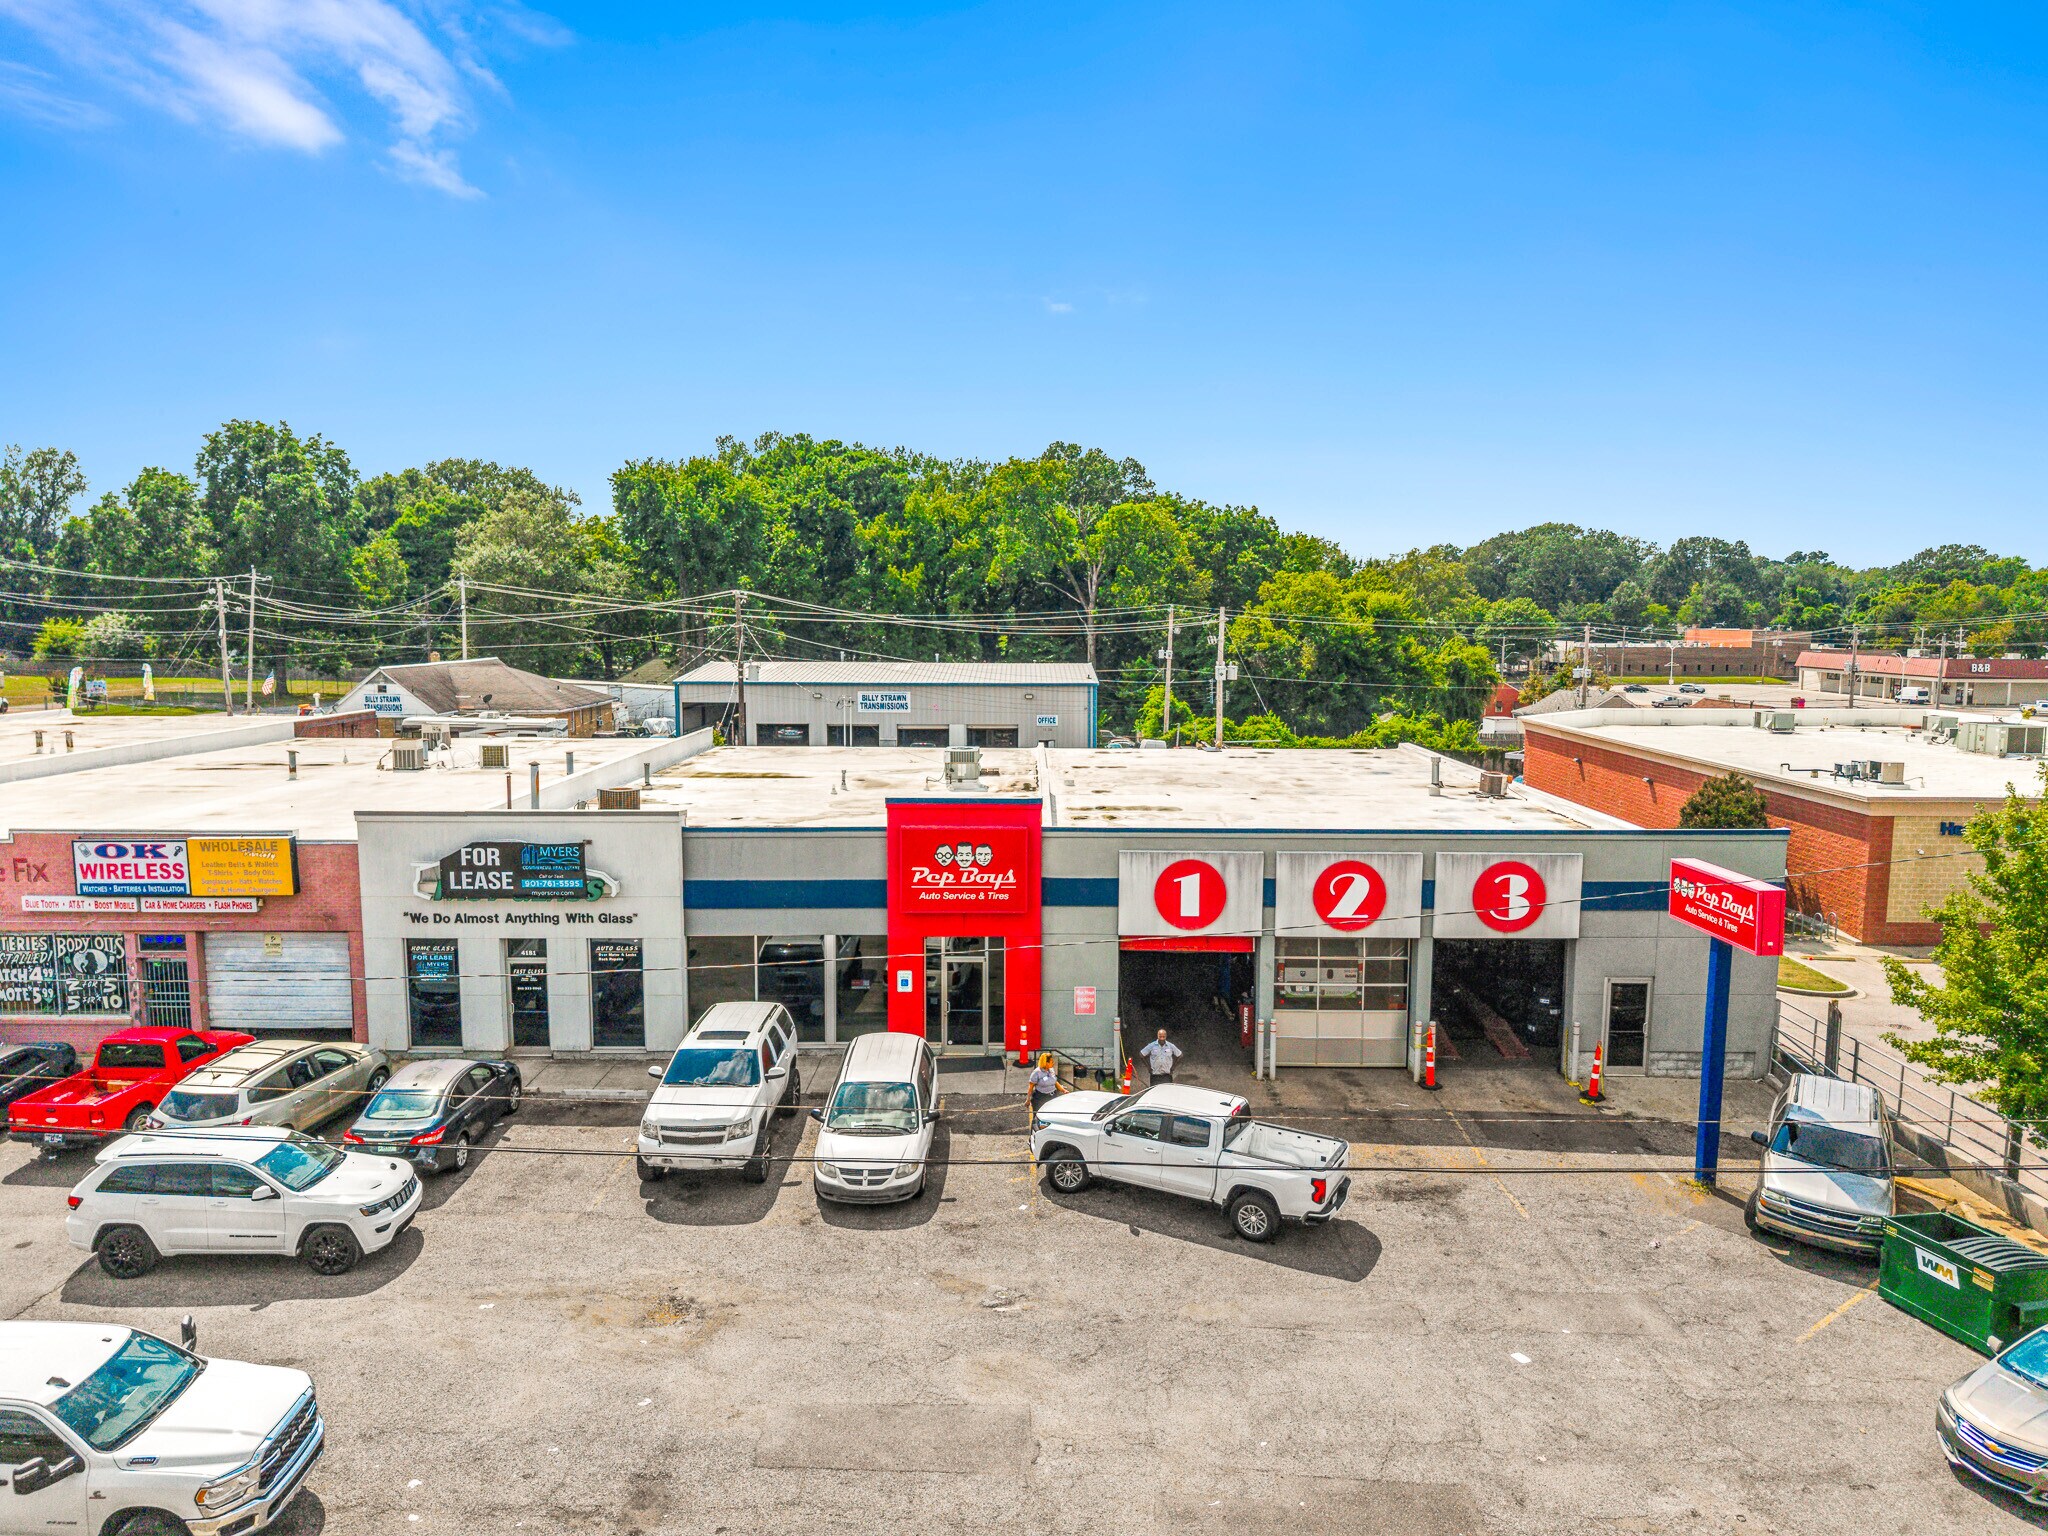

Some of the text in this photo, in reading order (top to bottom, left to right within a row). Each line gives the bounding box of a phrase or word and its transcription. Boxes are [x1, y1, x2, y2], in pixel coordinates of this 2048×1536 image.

[1971, 663, 1991, 673] B&B
[94, 844, 169, 859] OK
[199, 841, 279, 852] WHOLESALE
[540, 846, 580, 857] MYERS
[460, 847, 500, 866] FOR
[79, 863, 185, 880] WIRELESS
[911, 866, 1017, 890] Pep Boys
[148, 884, 185, 893] INSTALLATION
[450, 871, 514, 890] LEASE
[918, 892, 941, 900] Auto
[942, 892, 976, 900] Service
[988, 892, 1010, 900] Tires
[1173, 872, 1200, 917] 1
[1327, 873, 1370, 919] 2
[1489, 873, 1532, 921] 3
[1696, 882, 1755, 924] Pep Boys
[25, 900, 135, 910] BLUE TOOTH AT&T BOOST MOBILE
[144, 901, 155, 910] CAR
[163, 901, 178, 910] HOME
[179, 901, 206, 910] CHARGERS
[214, 901, 230, 910] FLASH
[232, 901, 253, 910] PHONES
[433, 913, 451, 923] Do
[454, 913, 500, 924] Almost
[505, 912, 560, 925] Anything
[566, 912, 594, 923] With
[1684, 904, 1739, 933] Auto Service & Tires
[56, 937, 90, 958] BODY
[67, 996, 81, 1010] 5
[1921, 1255, 1954, 1281] WM
